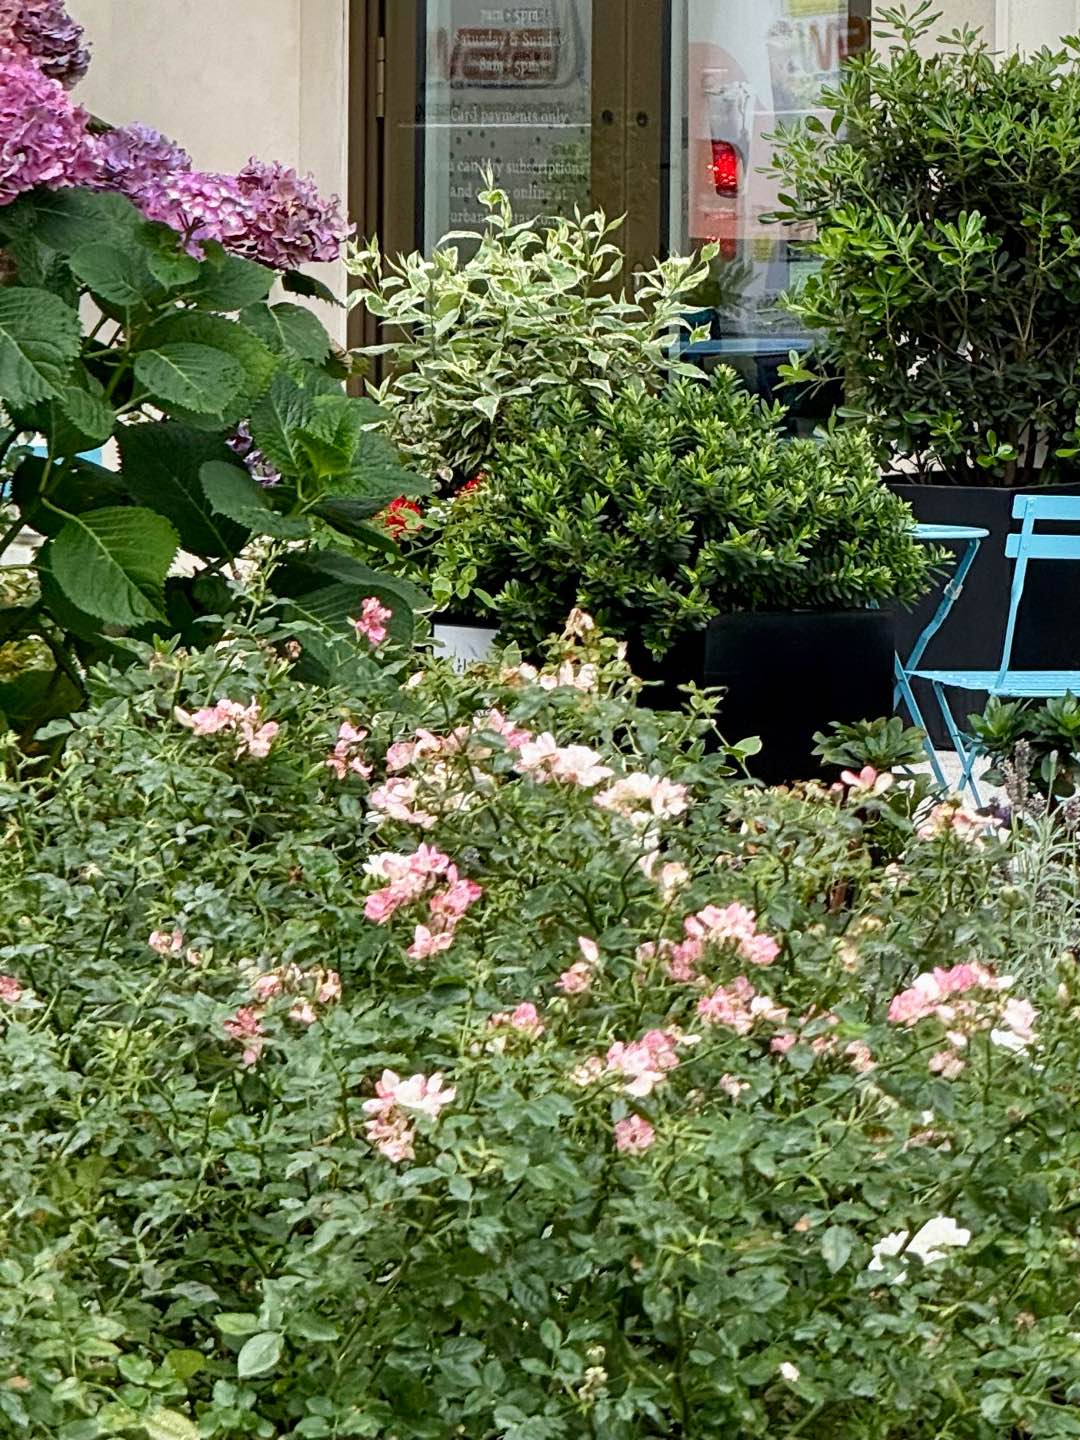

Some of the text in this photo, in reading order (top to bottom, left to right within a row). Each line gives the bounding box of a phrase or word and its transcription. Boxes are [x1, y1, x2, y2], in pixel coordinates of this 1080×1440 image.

[450, 106, 478, 123] Card
[480, 107, 539, 125] payments
[505, 158, 586, 180] subscriptions
[449, 182, 473, 198] and
